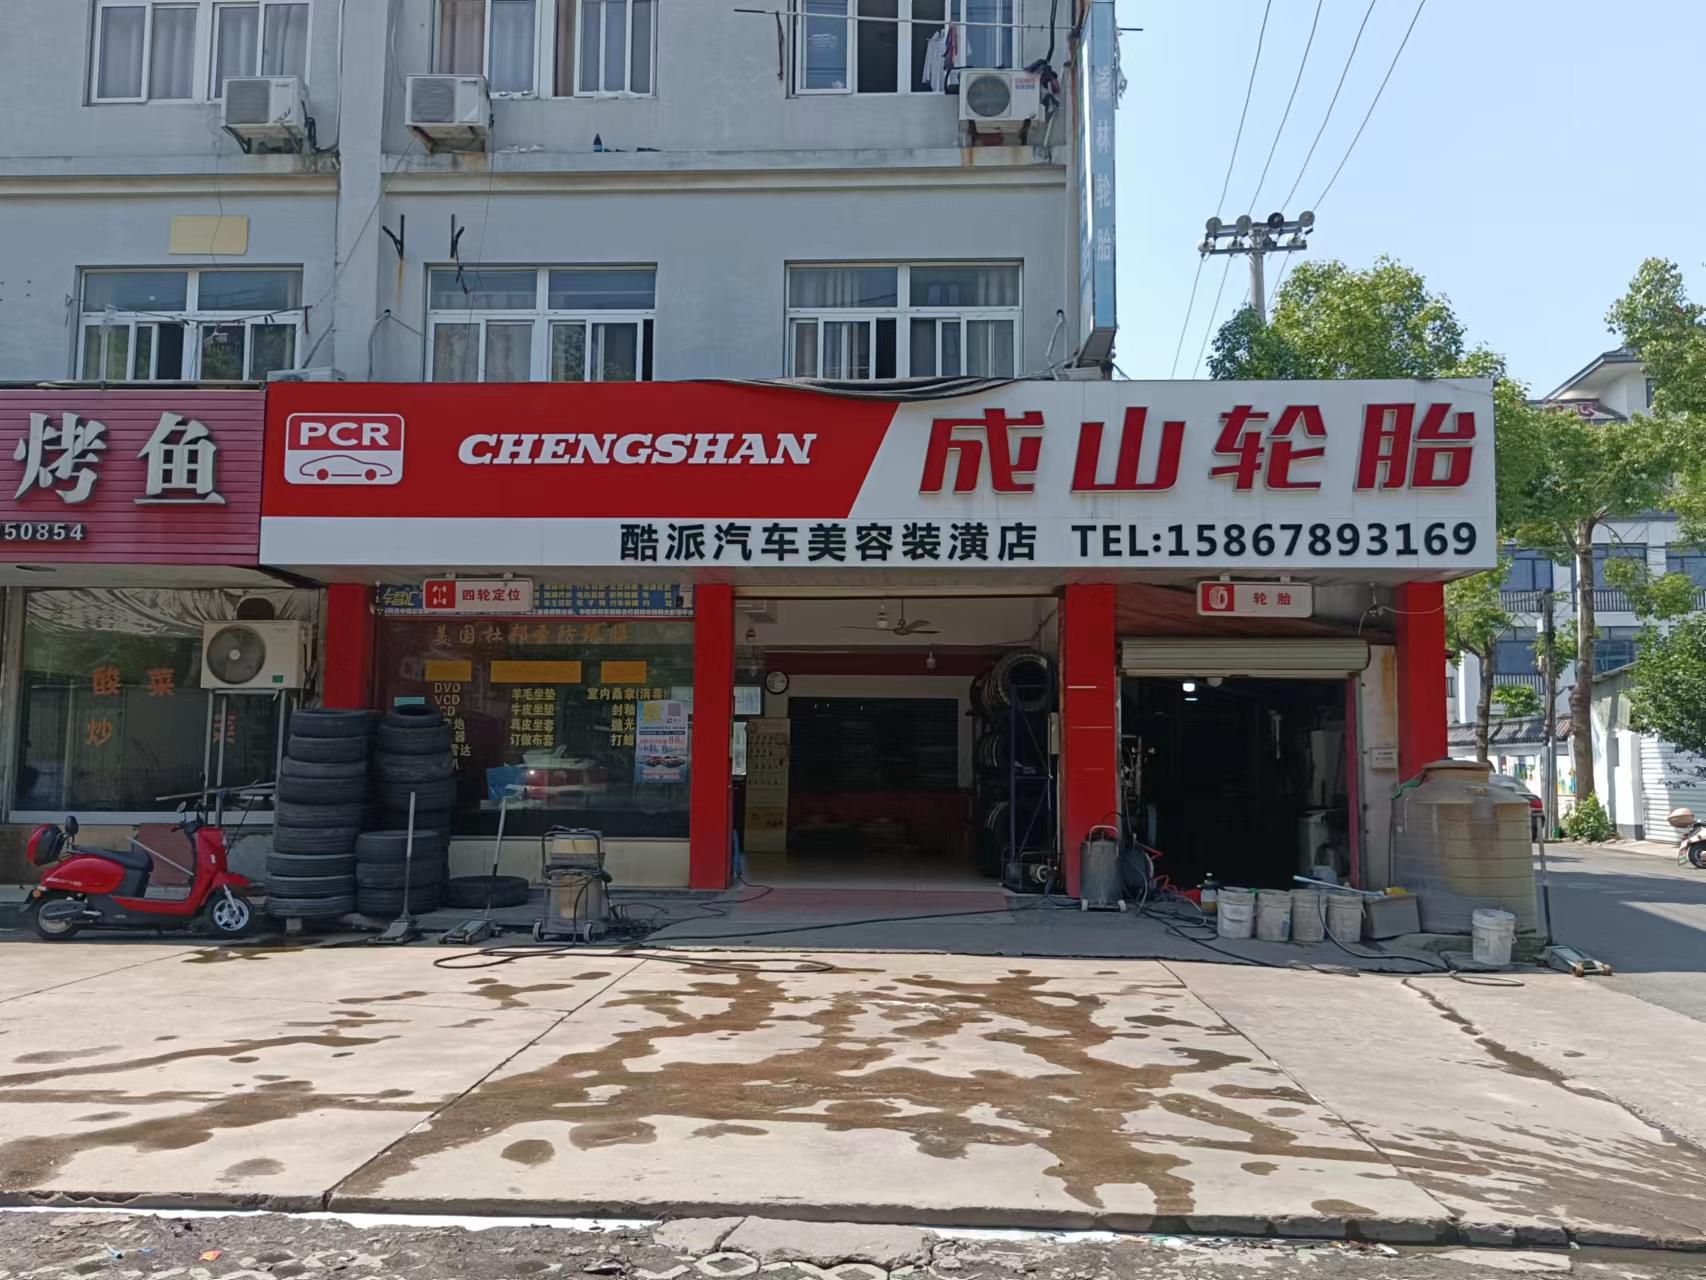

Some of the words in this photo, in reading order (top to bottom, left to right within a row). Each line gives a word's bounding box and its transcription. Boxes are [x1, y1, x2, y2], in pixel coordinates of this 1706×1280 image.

[300, 422, 390, 447] PCR
[458, 432, 818, 466] CHENGSHAN
[918, 403, 1476, 495] 成山轮胎
[13, 411, 227, 505] 烤鱼
[620, 522, 1037, 563] 酷派汽车美容装潢店
[1072, 522, 1477, 558] TEL:15867893169
[462, 588, 521, 602] 四轮定位
[1252, 591, 1292, 606] 轮胎
[434, 682, 461, 694] DVD
[434, 694, 461, 705] VCD
